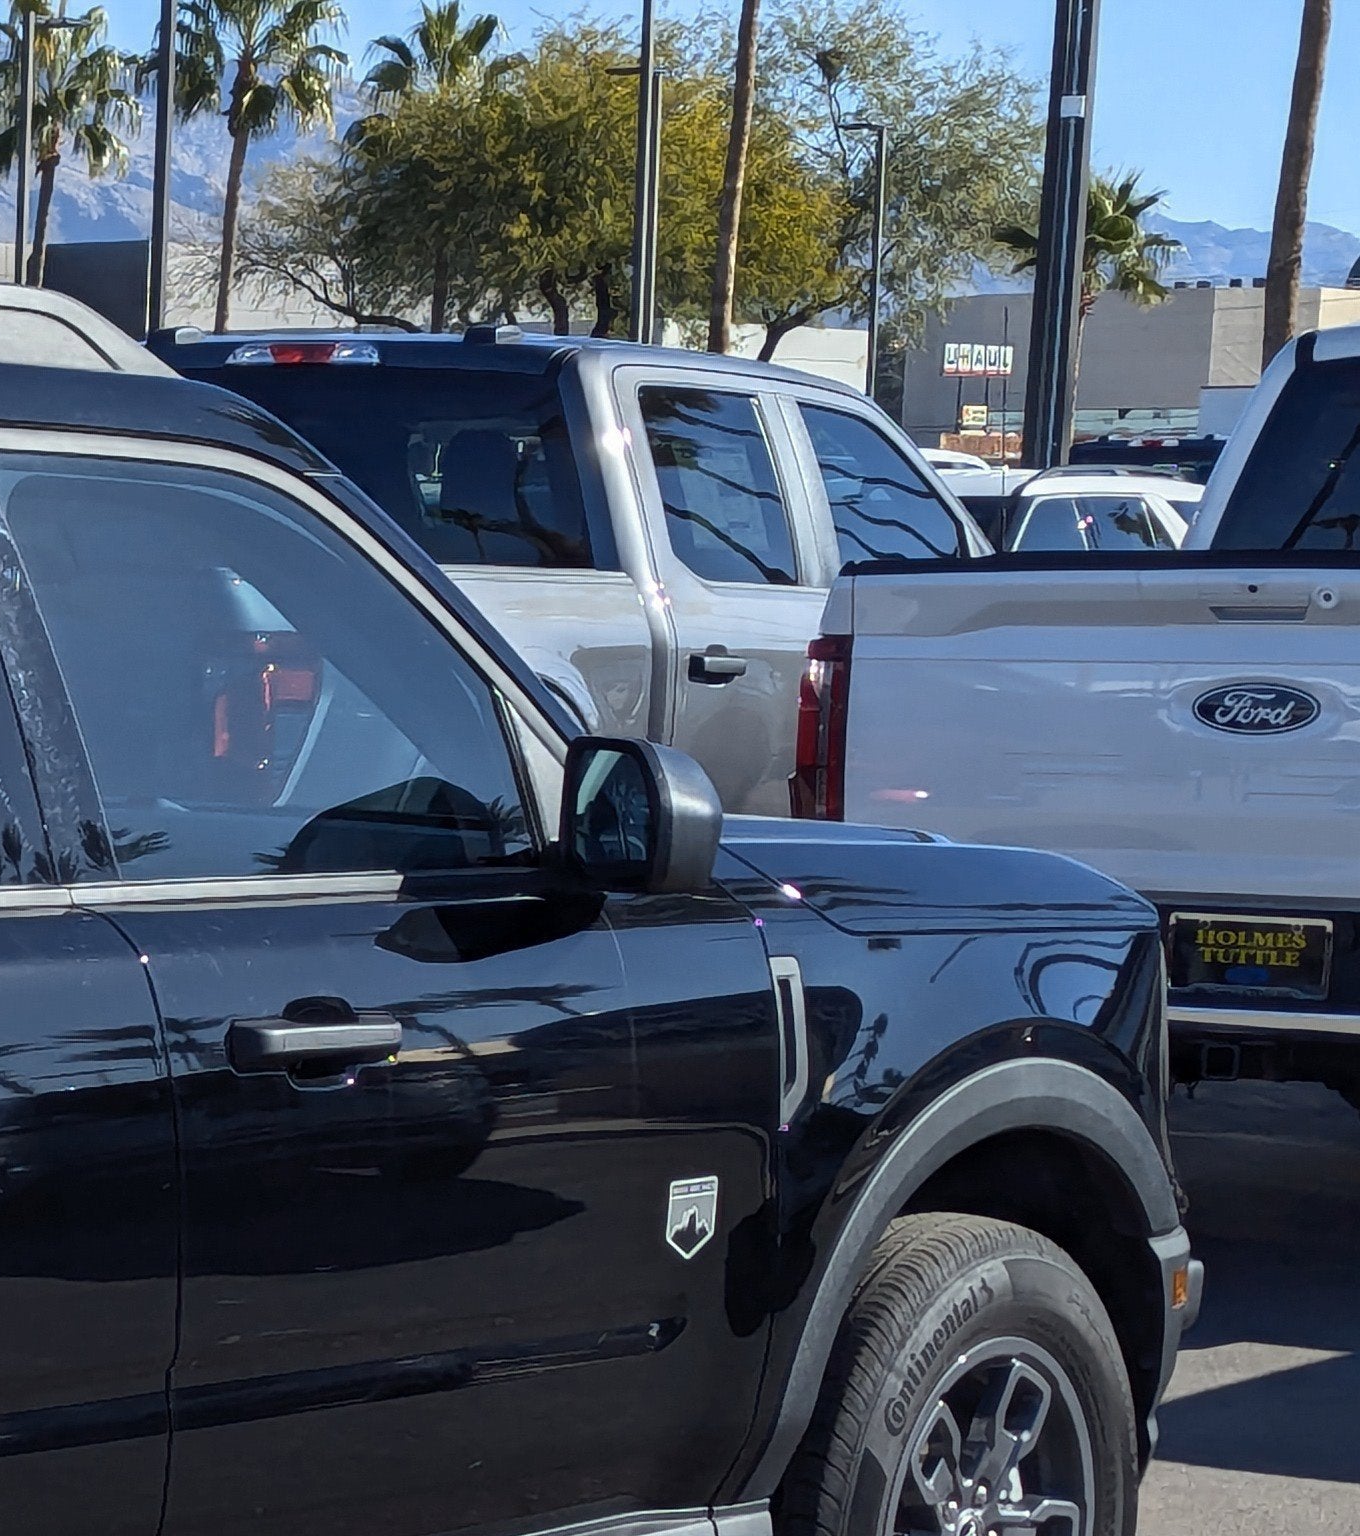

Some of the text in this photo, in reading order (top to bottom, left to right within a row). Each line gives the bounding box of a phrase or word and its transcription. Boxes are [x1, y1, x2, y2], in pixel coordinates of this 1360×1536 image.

[1215, 691, 1295, 725] Ford
[1195, 929, 1307, 949] HOLMES
[1199, 947, 1300, 967] TUTTLE
[884, 1285, 979, 1437] Continental
